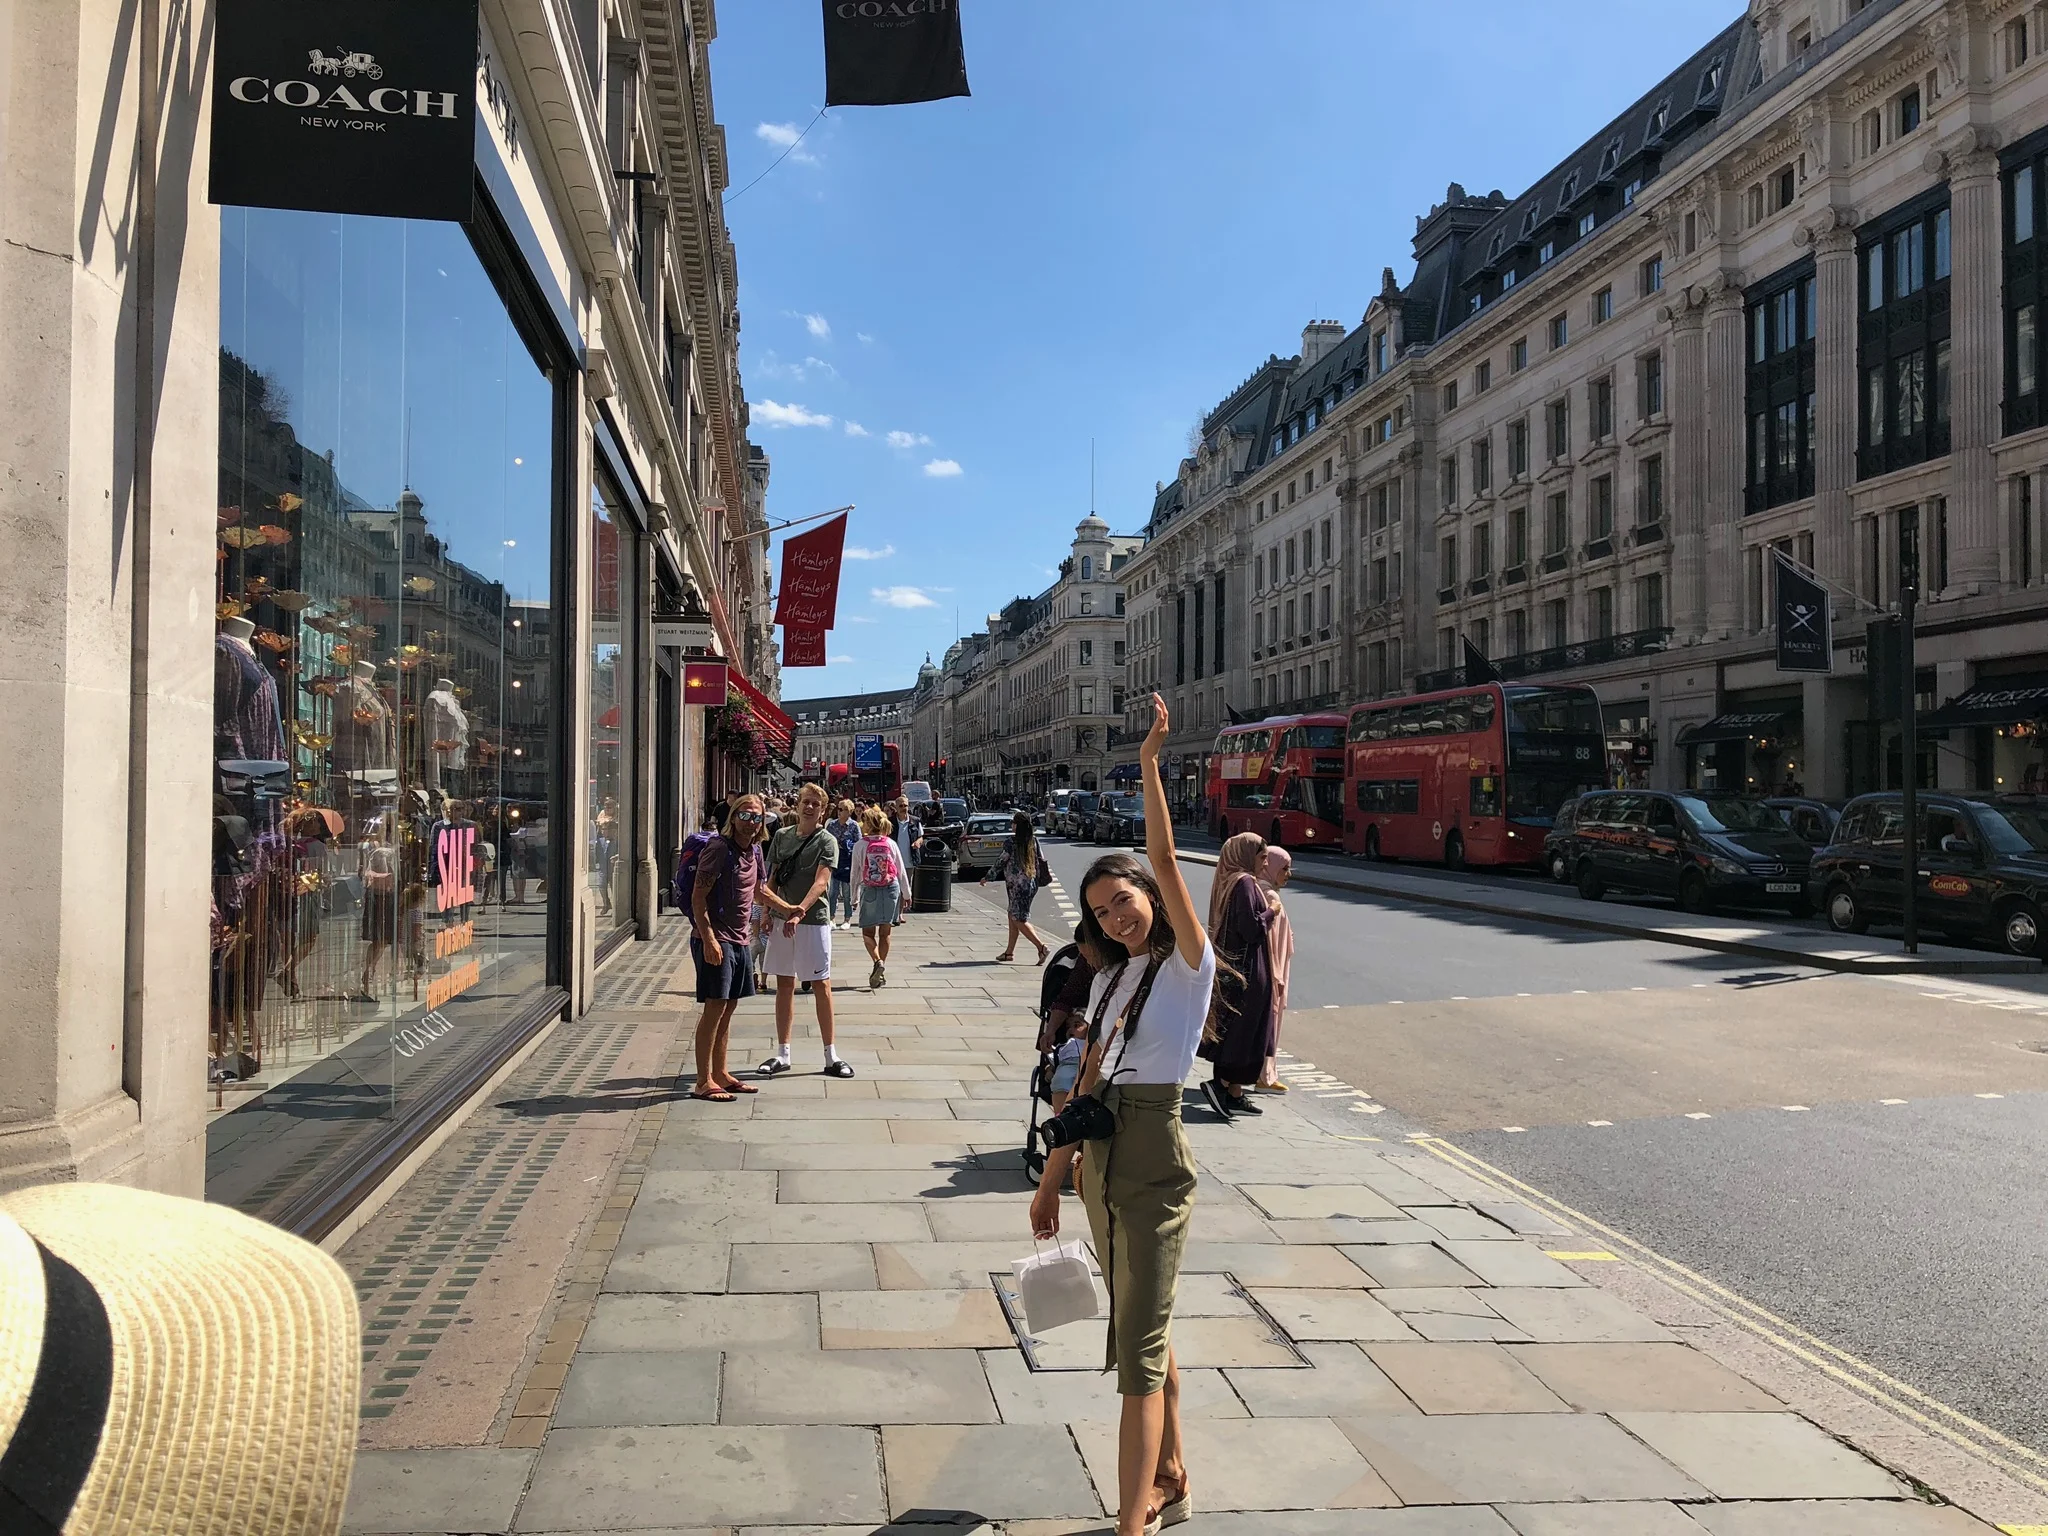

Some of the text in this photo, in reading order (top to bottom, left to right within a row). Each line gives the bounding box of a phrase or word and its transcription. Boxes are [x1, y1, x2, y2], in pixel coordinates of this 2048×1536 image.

[835, 0, 947, 18] COACH
[229, 76, 458, 119] COACH
[300, 116, 387, 132] NEW YORK
[790, 547, 834, 571] Hamleys
[788, 574, 831, 598] Hamleys
[784, 600, 828, 624] Hamleys
[790, 629, 820, 643] Hamleys
[789, 648, 820, 663] Hamleys
[1713, 712, 1785, 724] HACKETT
[1575, 747, 1590, 759] 88
[436, 827, 475, 912] SALE
[1932, 878, 1968, 893] ComCab
[1132, 986, 1148, 1016] Canon
[390, 1010, 454, 1058] COACH
